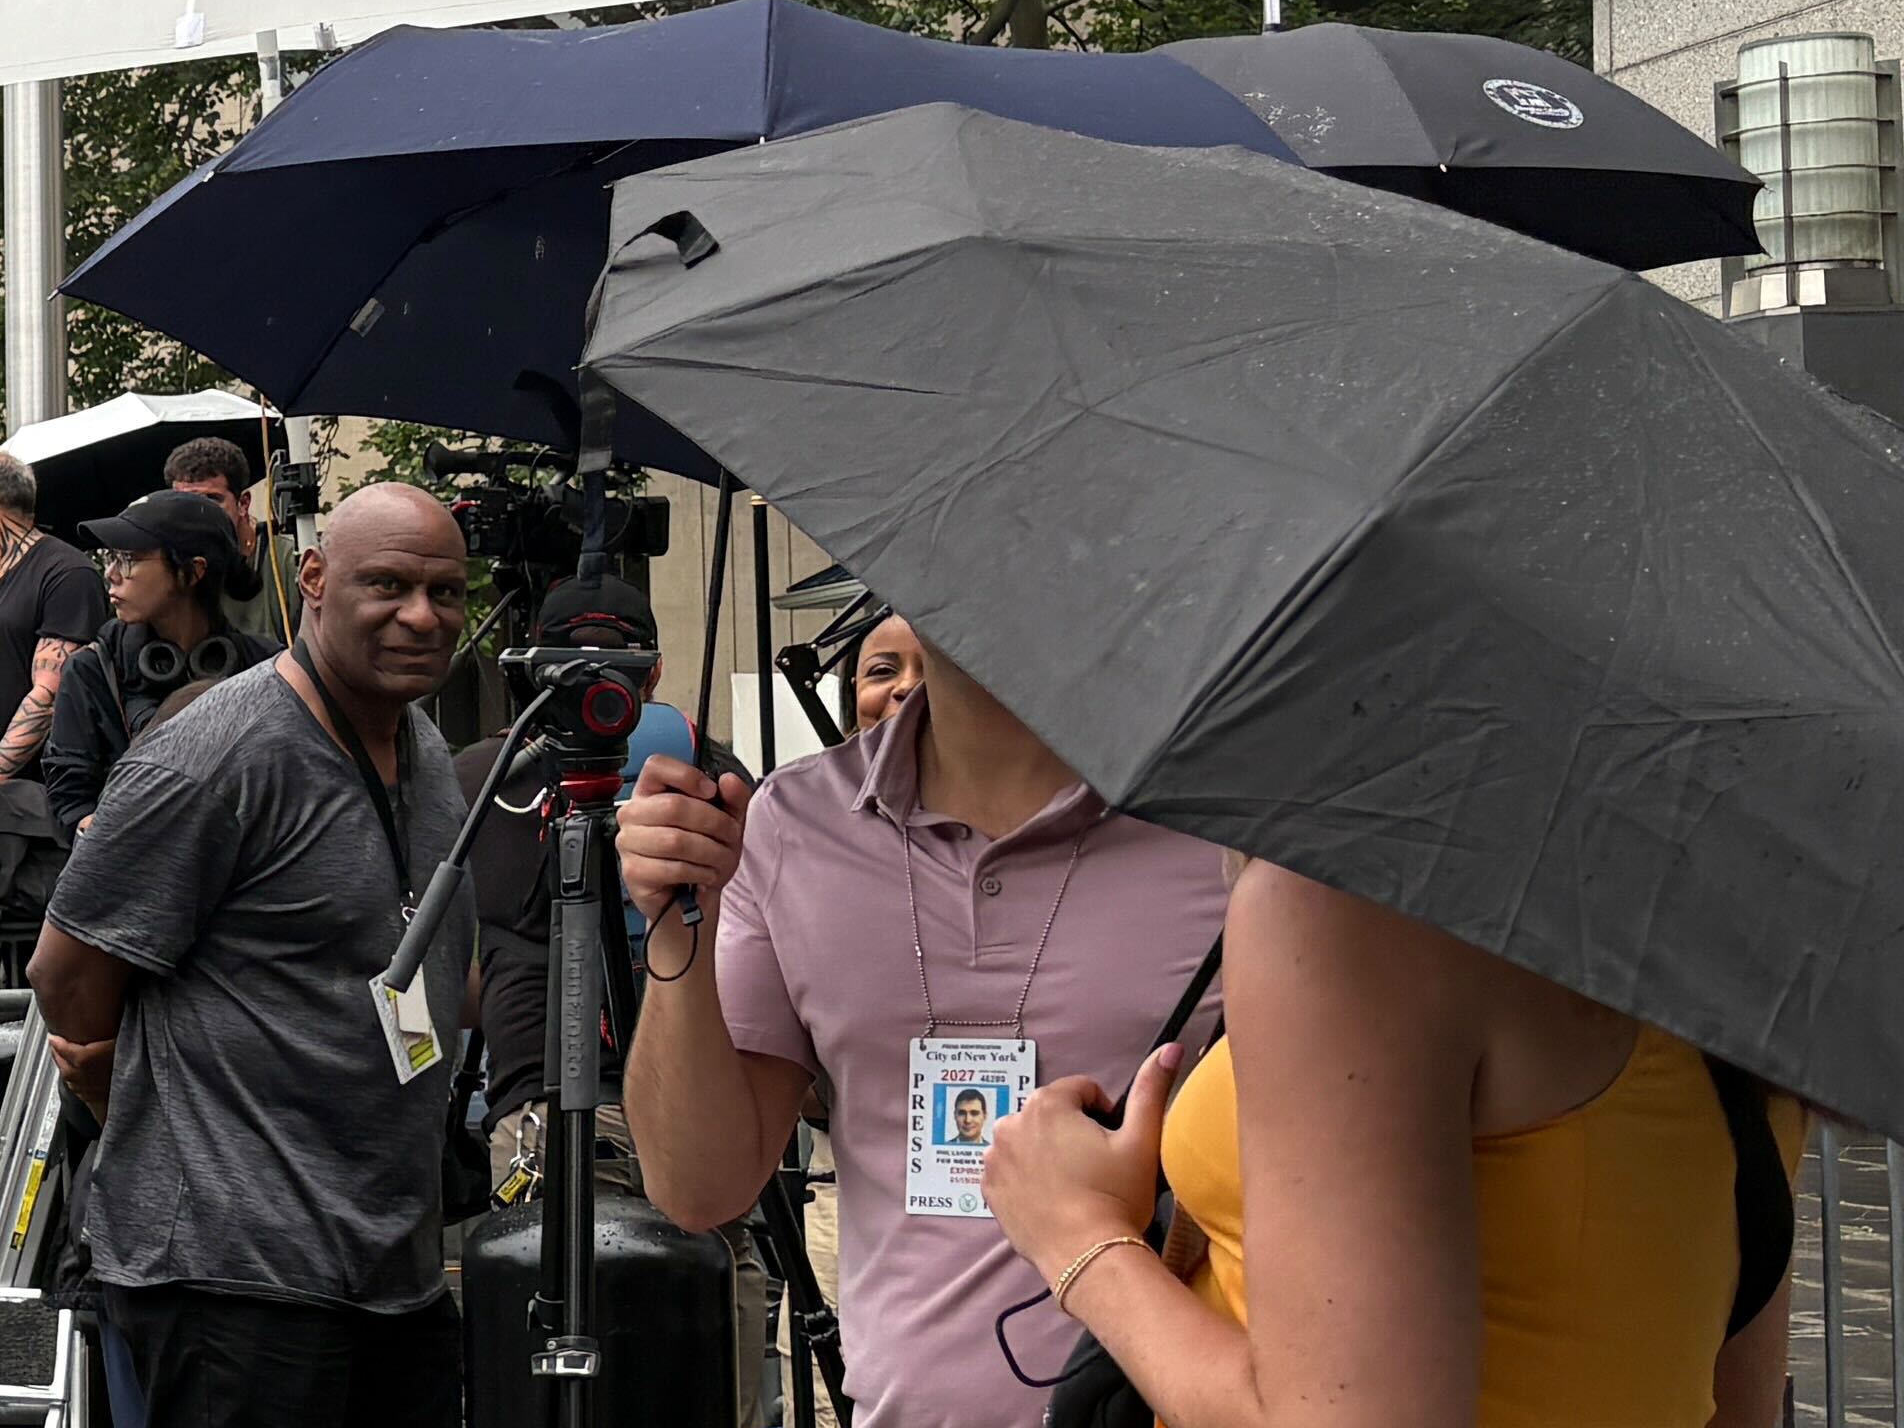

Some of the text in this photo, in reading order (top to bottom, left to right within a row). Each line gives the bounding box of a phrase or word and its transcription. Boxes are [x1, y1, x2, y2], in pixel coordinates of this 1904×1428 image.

[926, 1051, 1018, 1063] City of New York
[941, 1069, 975, 1082] 2027
[911, 1073, 926, 1174] PRESS
[910, 1195, 953, 1209] PRESS
